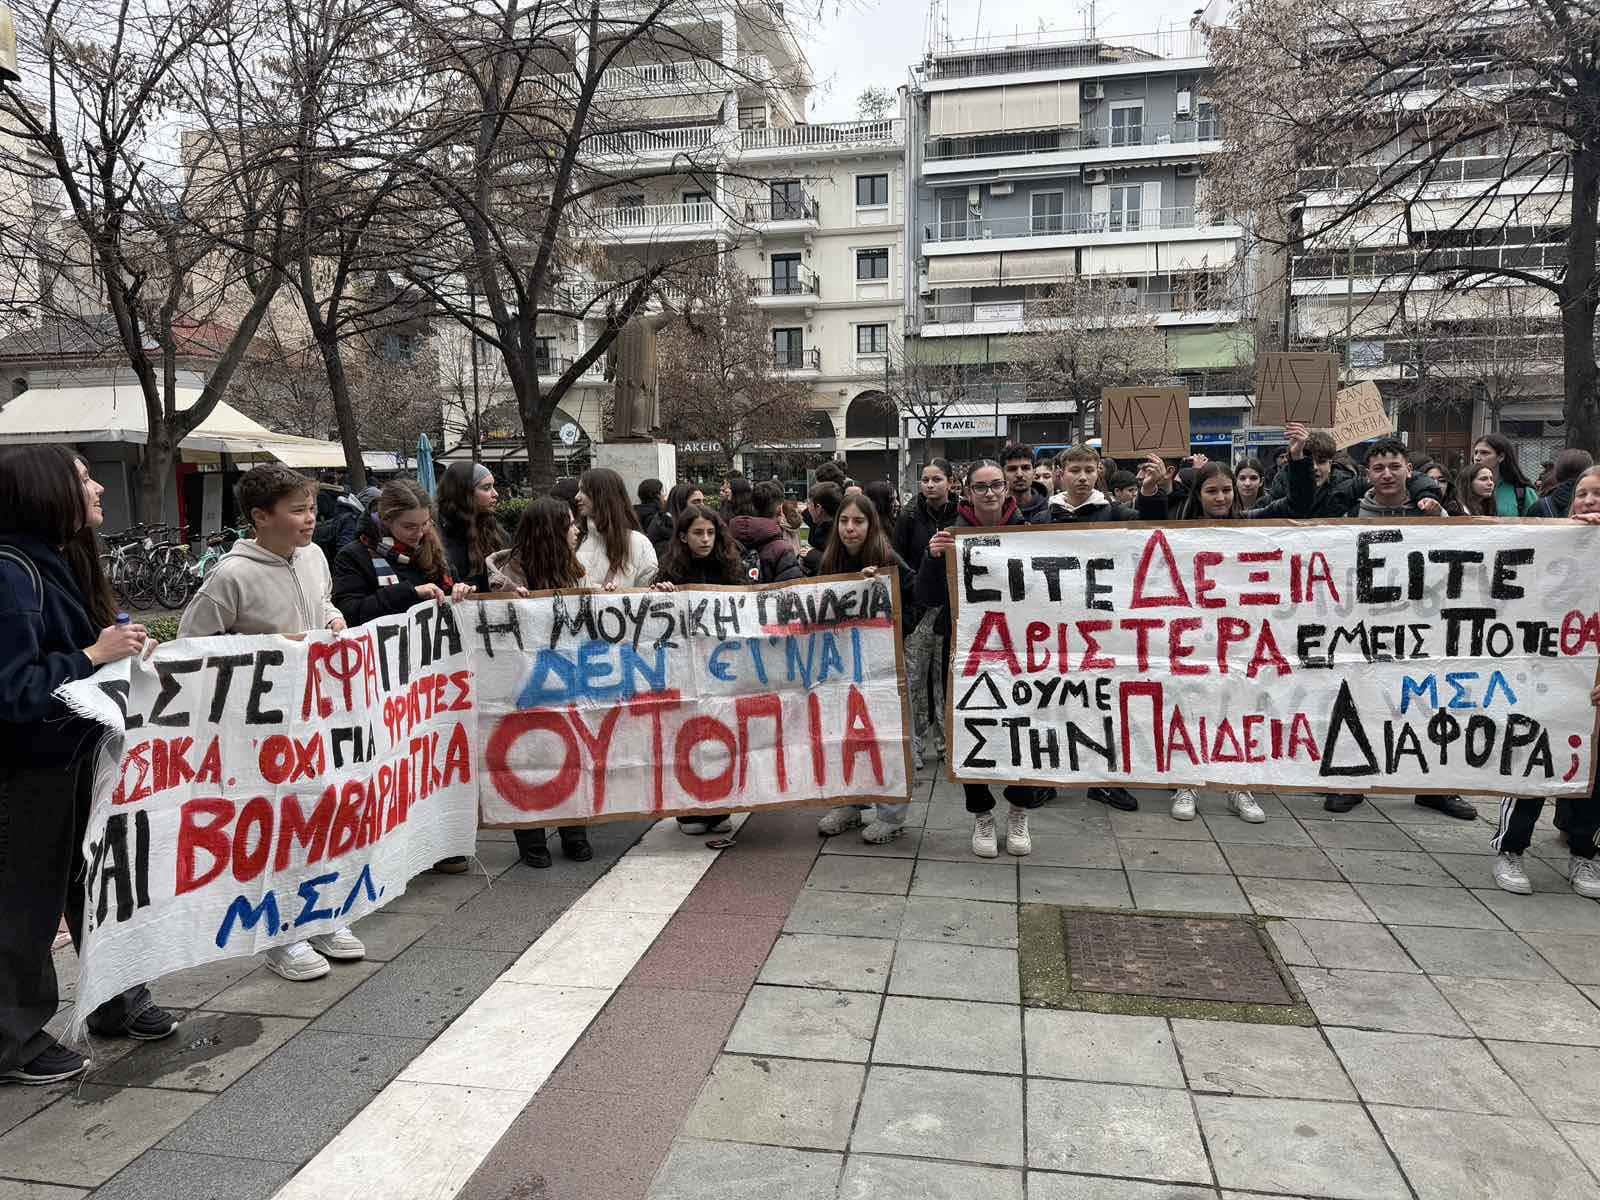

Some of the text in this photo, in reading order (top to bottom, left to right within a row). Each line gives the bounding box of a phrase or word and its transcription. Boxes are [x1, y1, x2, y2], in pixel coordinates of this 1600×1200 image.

[1106, 394, 1186, 452] ΜΣΛ
[1256, 357, 1333, 425] ΜΣΛ
[940, 420, 976, 430] TRAVEL
[962, 528, 1537, 612] ΕΙΤΕ ΔΕΞΙΑ ΕΙΤΕ
[415, 602, 463, 669] ΤΑ
[475, 598, 525, 658] Η
[756, 581, 893, 629] ΠΑΙΔΕΙΑ
[1297, 619, 1431, 669] ΕΜΕΙΣ
[1440, 607, 1560, 658] ΠΟΤΕ
[1559, 608, 1600, 657] ΘΑ
[515, 637, 670, 710] ΔΕΝ
[956, 670, 1112, 711] ΔΟΥΜΕ
[1400, 670, 1518, 715] ΜΣΛ
[330, 720, 376, 769] ΓΙΑ
[485, 684, 886, 814] ΟΥΤΟΠΙΑ
[959, 678, 1583, 782] ΣΤΗΝ ΠΑΙΔΕΙΑ ΔΙΑΦΟΡΑ;
